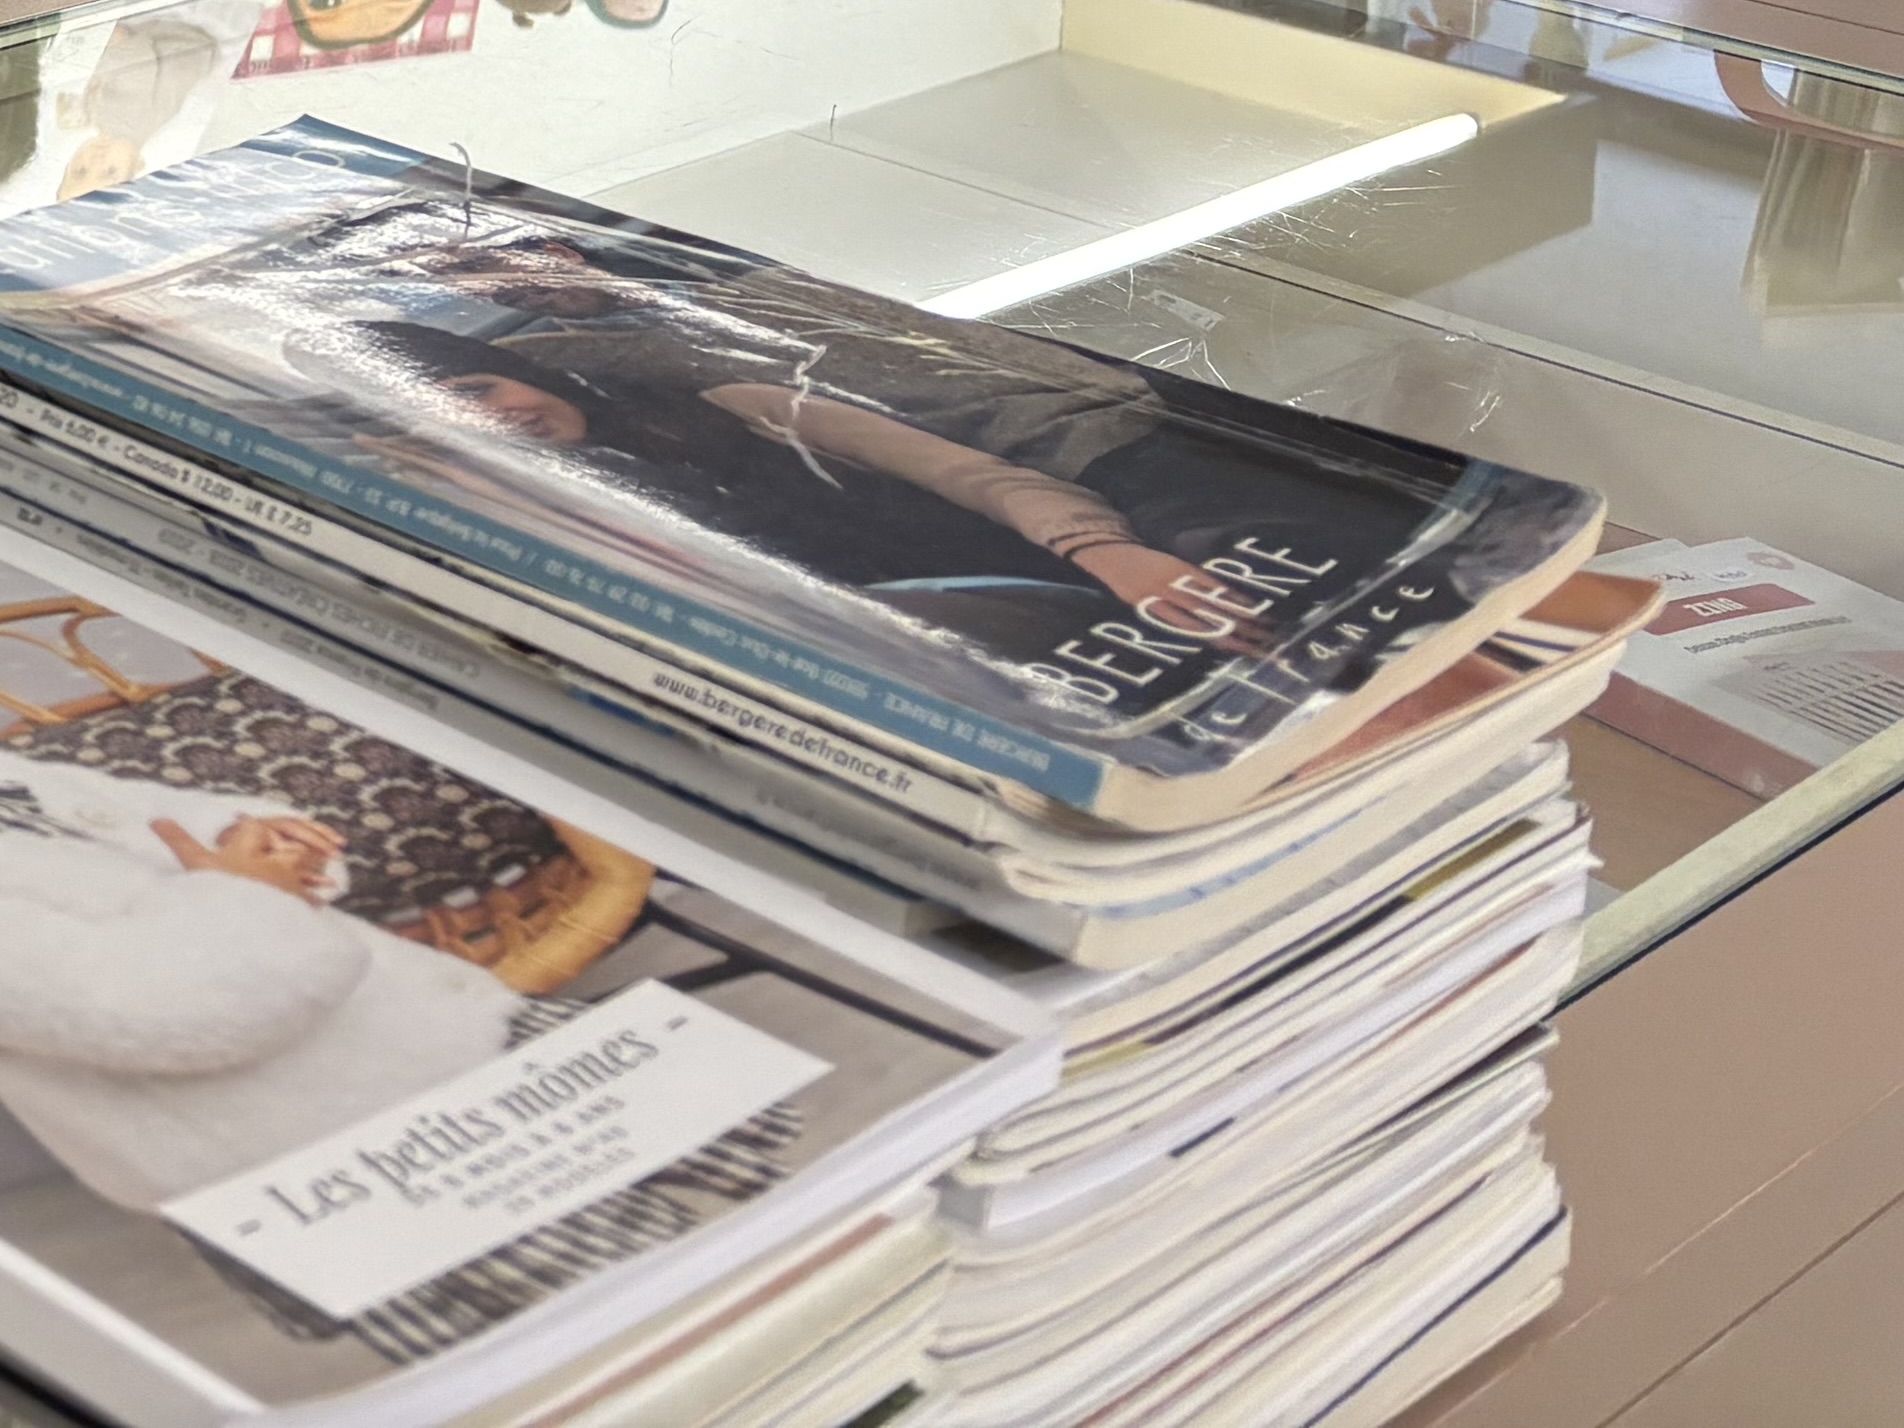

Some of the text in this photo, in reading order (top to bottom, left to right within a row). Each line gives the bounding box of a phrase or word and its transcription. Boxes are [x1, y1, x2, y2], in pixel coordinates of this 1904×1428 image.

[122, 443, 179, 480] Canada
[1021, 535, 1341, 710] BERGERE
[267, 1160, 370, 1229] Les
[359, 1109, 505, 1206] petits
[495, 1029, 660, 1122] mômes
